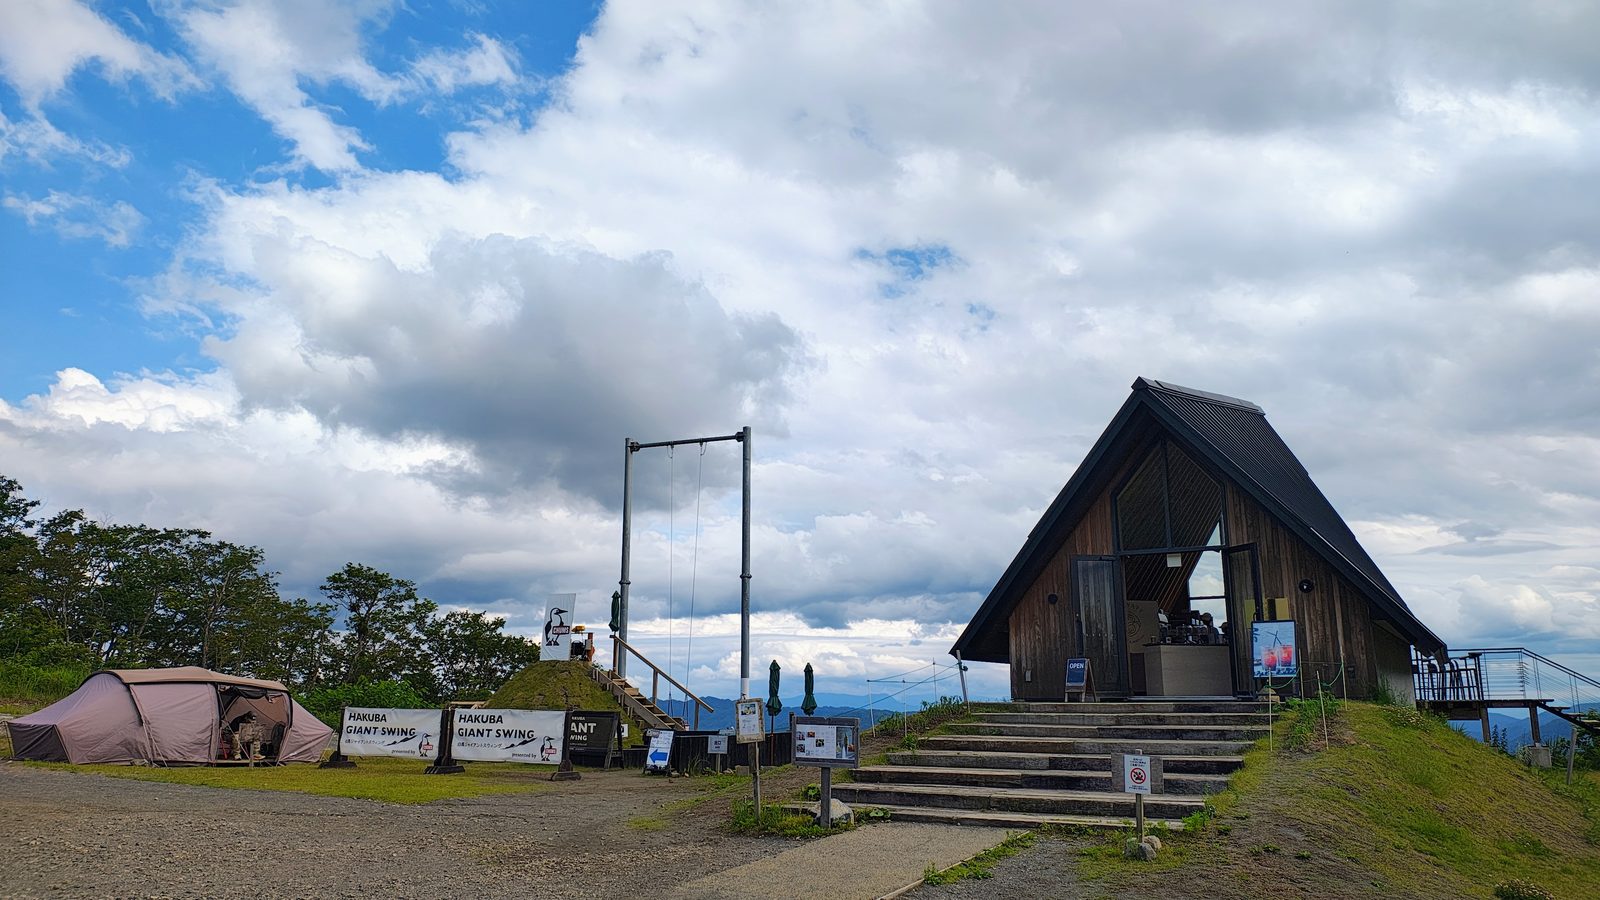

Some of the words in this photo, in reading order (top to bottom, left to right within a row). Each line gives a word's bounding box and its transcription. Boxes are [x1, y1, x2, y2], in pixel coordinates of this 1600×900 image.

[348, 713, 387, 722] HAKUBA
[458, 714, 504, 724] HAKUBA
[346, 725, 379, 735] GIANT
[380, 727, 416, 737] SWING
[457, 728, 492, 738] GIANT
[495, 728, 535, 739] SWING
[570, 722, 597, 734] ANT
